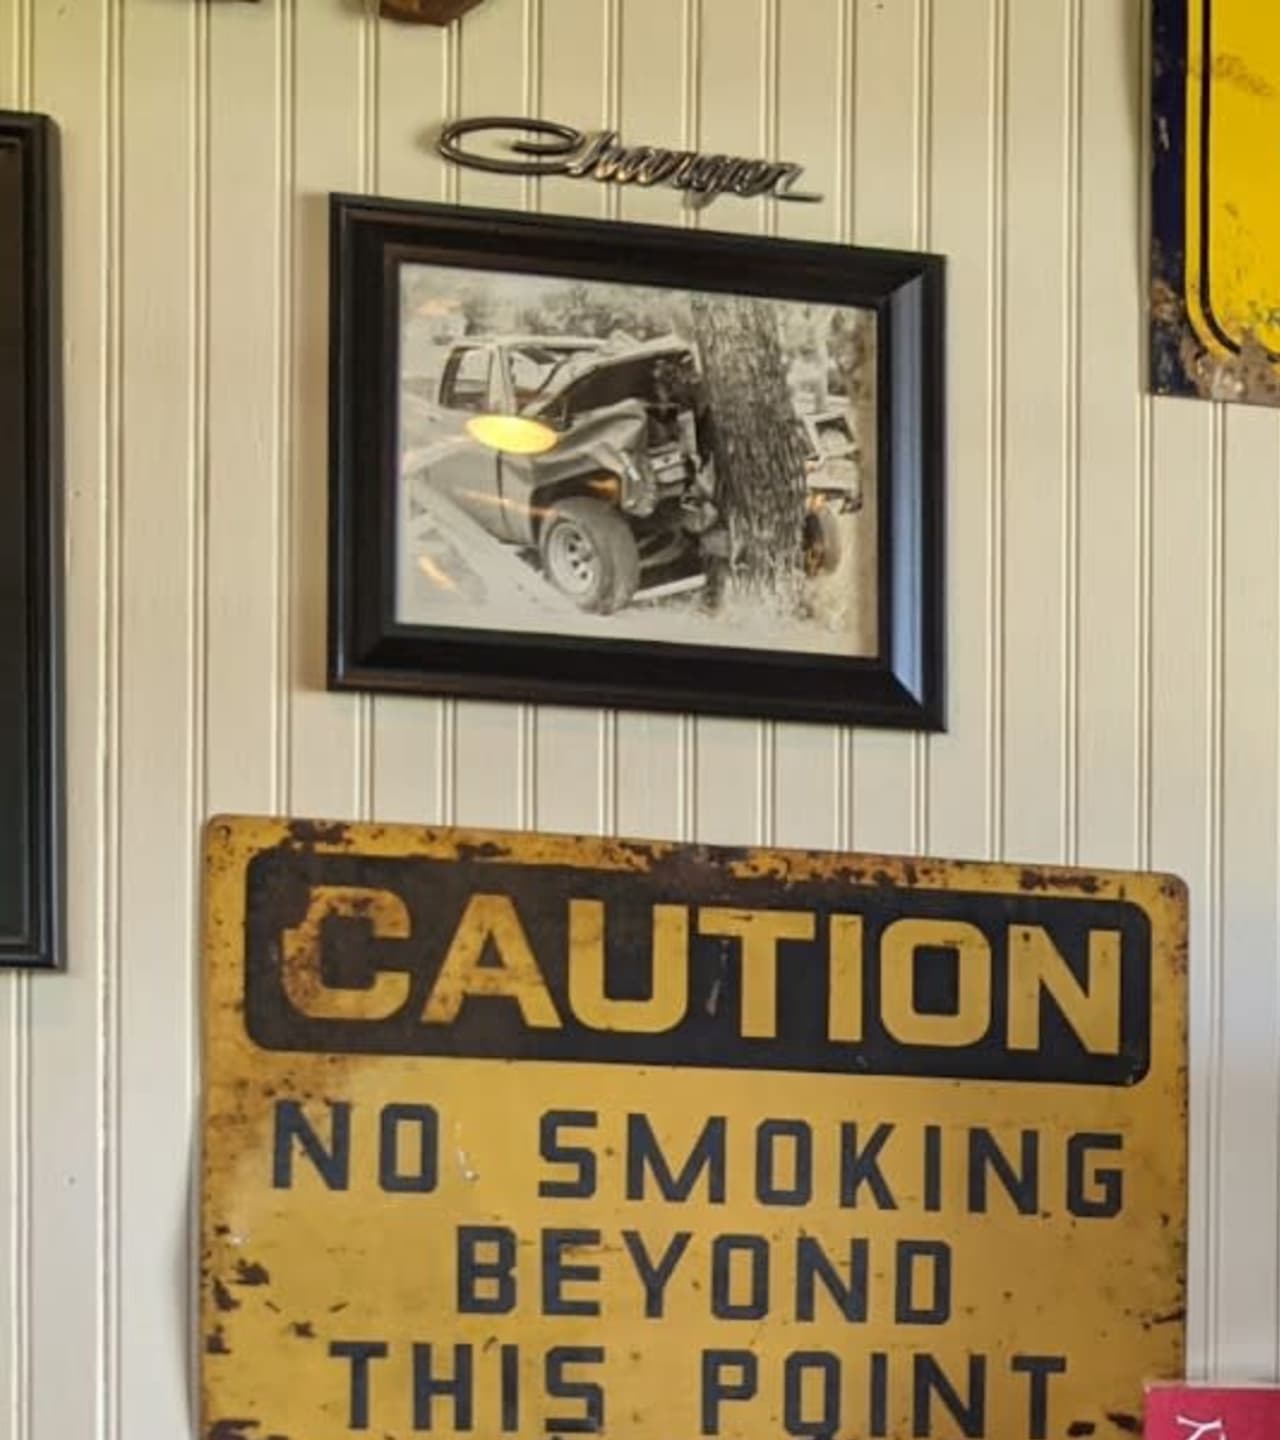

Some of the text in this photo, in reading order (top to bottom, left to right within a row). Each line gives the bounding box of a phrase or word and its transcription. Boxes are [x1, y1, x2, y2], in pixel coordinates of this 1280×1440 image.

[439, 116, 824, 208] Charger
[281, 884, 1123, 1055] CAUTION
[271, 1099, 1124, 1220] NO SMOKING
[456, 1224, 952, 1325] BEYOND
[329, 1341, 1067, 1440] THIS POINT
